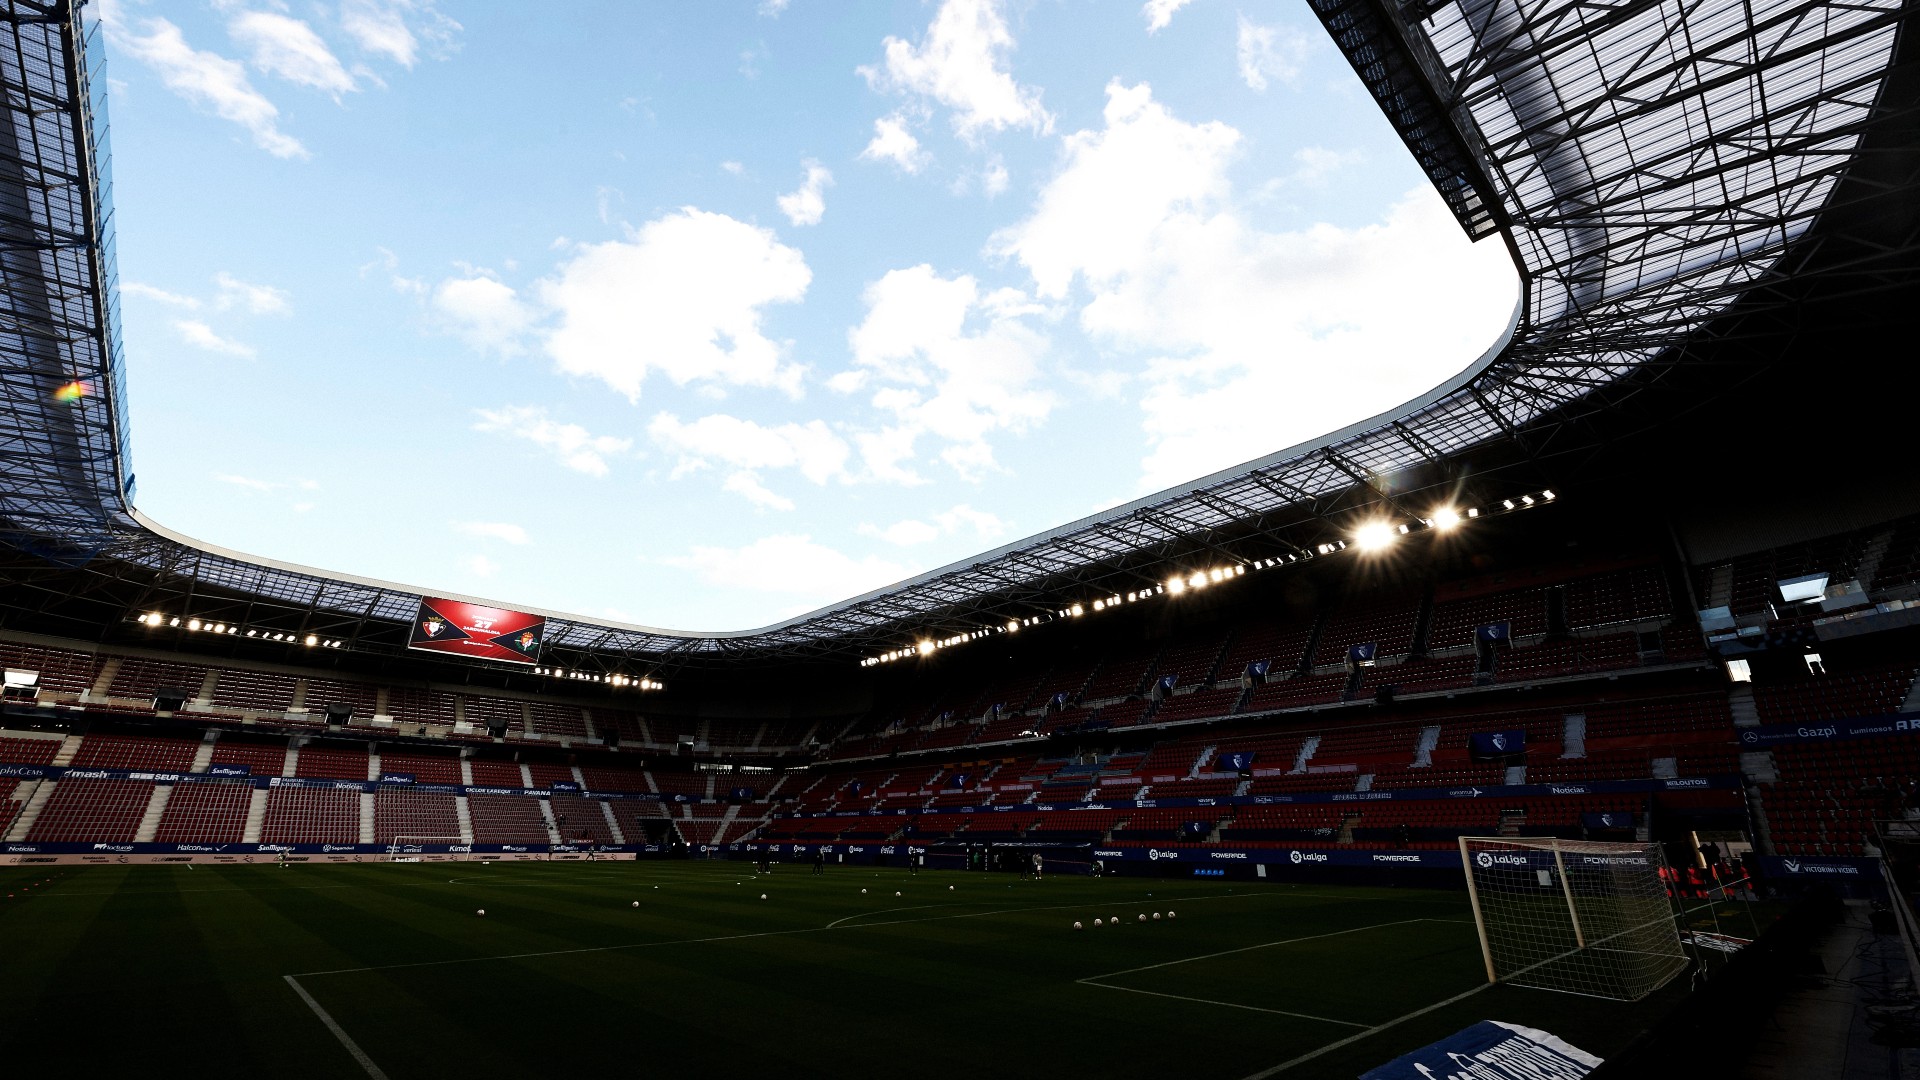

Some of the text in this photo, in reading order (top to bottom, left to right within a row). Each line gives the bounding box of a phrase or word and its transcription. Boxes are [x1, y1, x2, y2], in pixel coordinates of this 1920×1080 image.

[474, 619, 493, 629] 27
[1797, 725, 1837, 738] Gazpi
[1849, 726, 1893, 735] Luminosos
[154, 773, 180, 781] SEUR
[1551, 785, 1586, 794] Noticias
[1158, 850, 1178, 859] LaLiga
[1303, 852, 1328, 862] LaLiga
[1372, 854, 1421, 862] POWERADE
[1493, 853, 1528, 866] LaLiga
[1583, 856, 1648, 865] POWERADE
[1837, 867, 1859, 875] VICENTE
